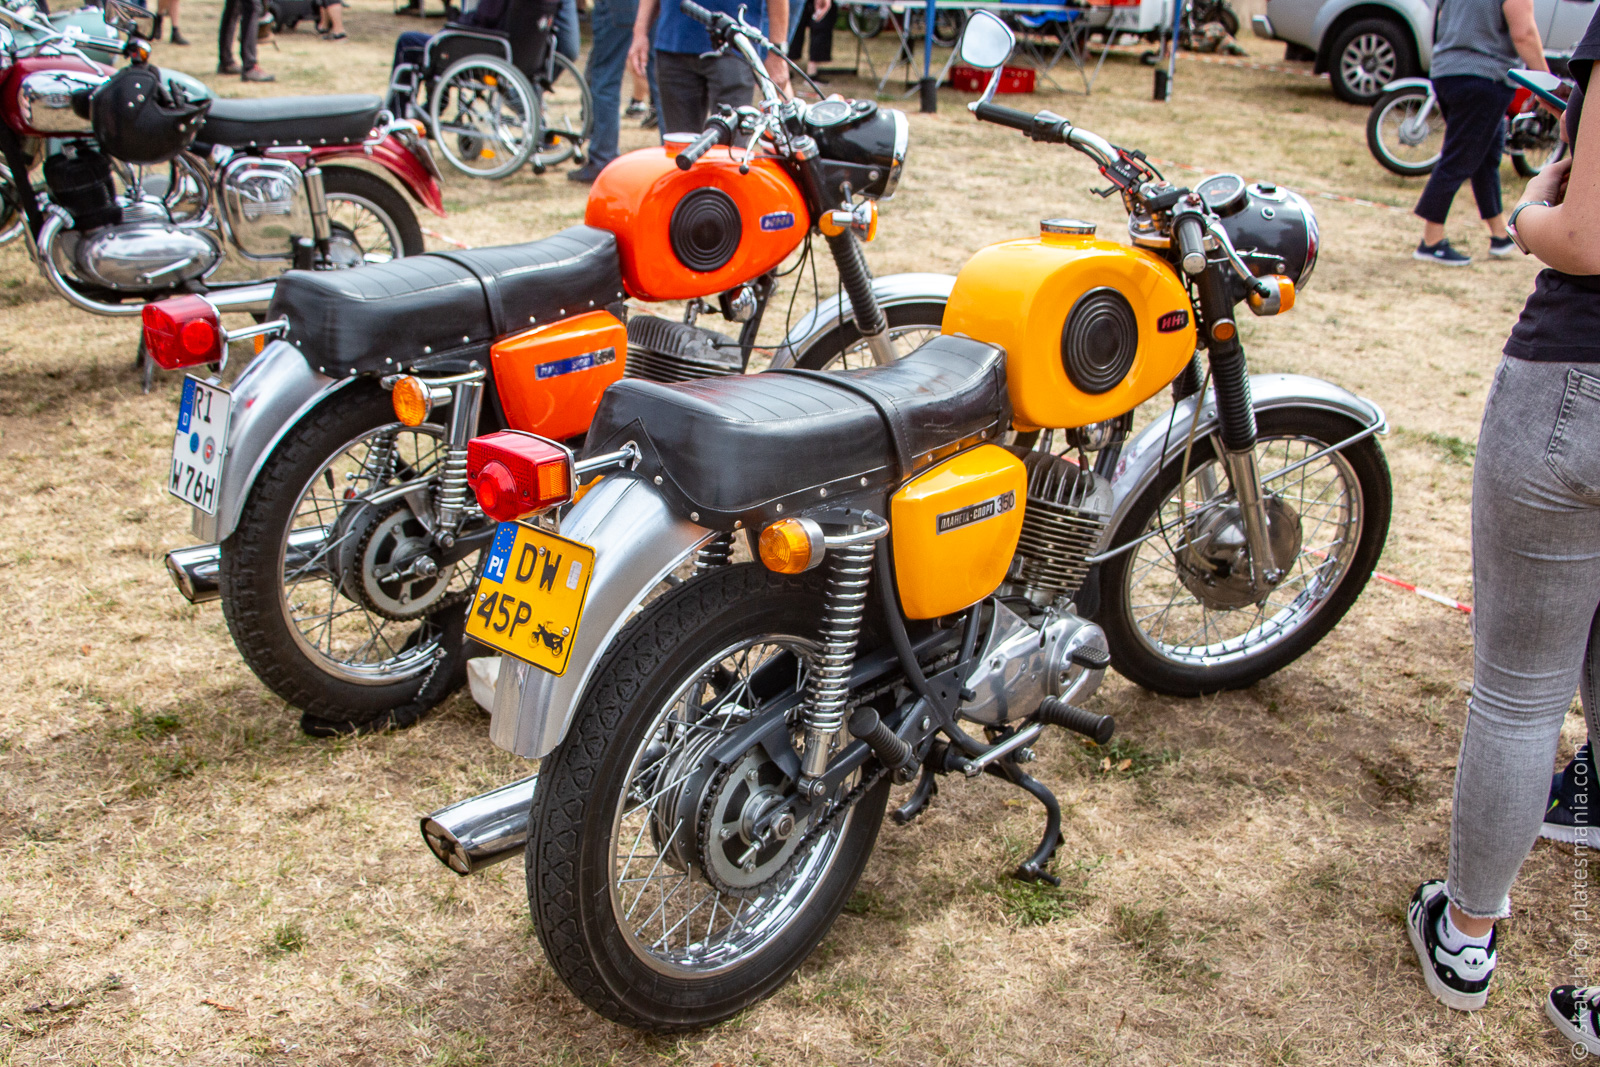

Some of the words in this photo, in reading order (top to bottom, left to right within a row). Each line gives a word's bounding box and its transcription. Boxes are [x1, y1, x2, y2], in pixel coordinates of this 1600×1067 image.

[192, 386, 213, 424] RI
[185, 465, 216, 510] 76H
[996, 492, 1015, 514] 350
[487, 555, 504, 578] PL
[515, 542, 563, 592] DW
[477, 591, 532, 638] 45P
